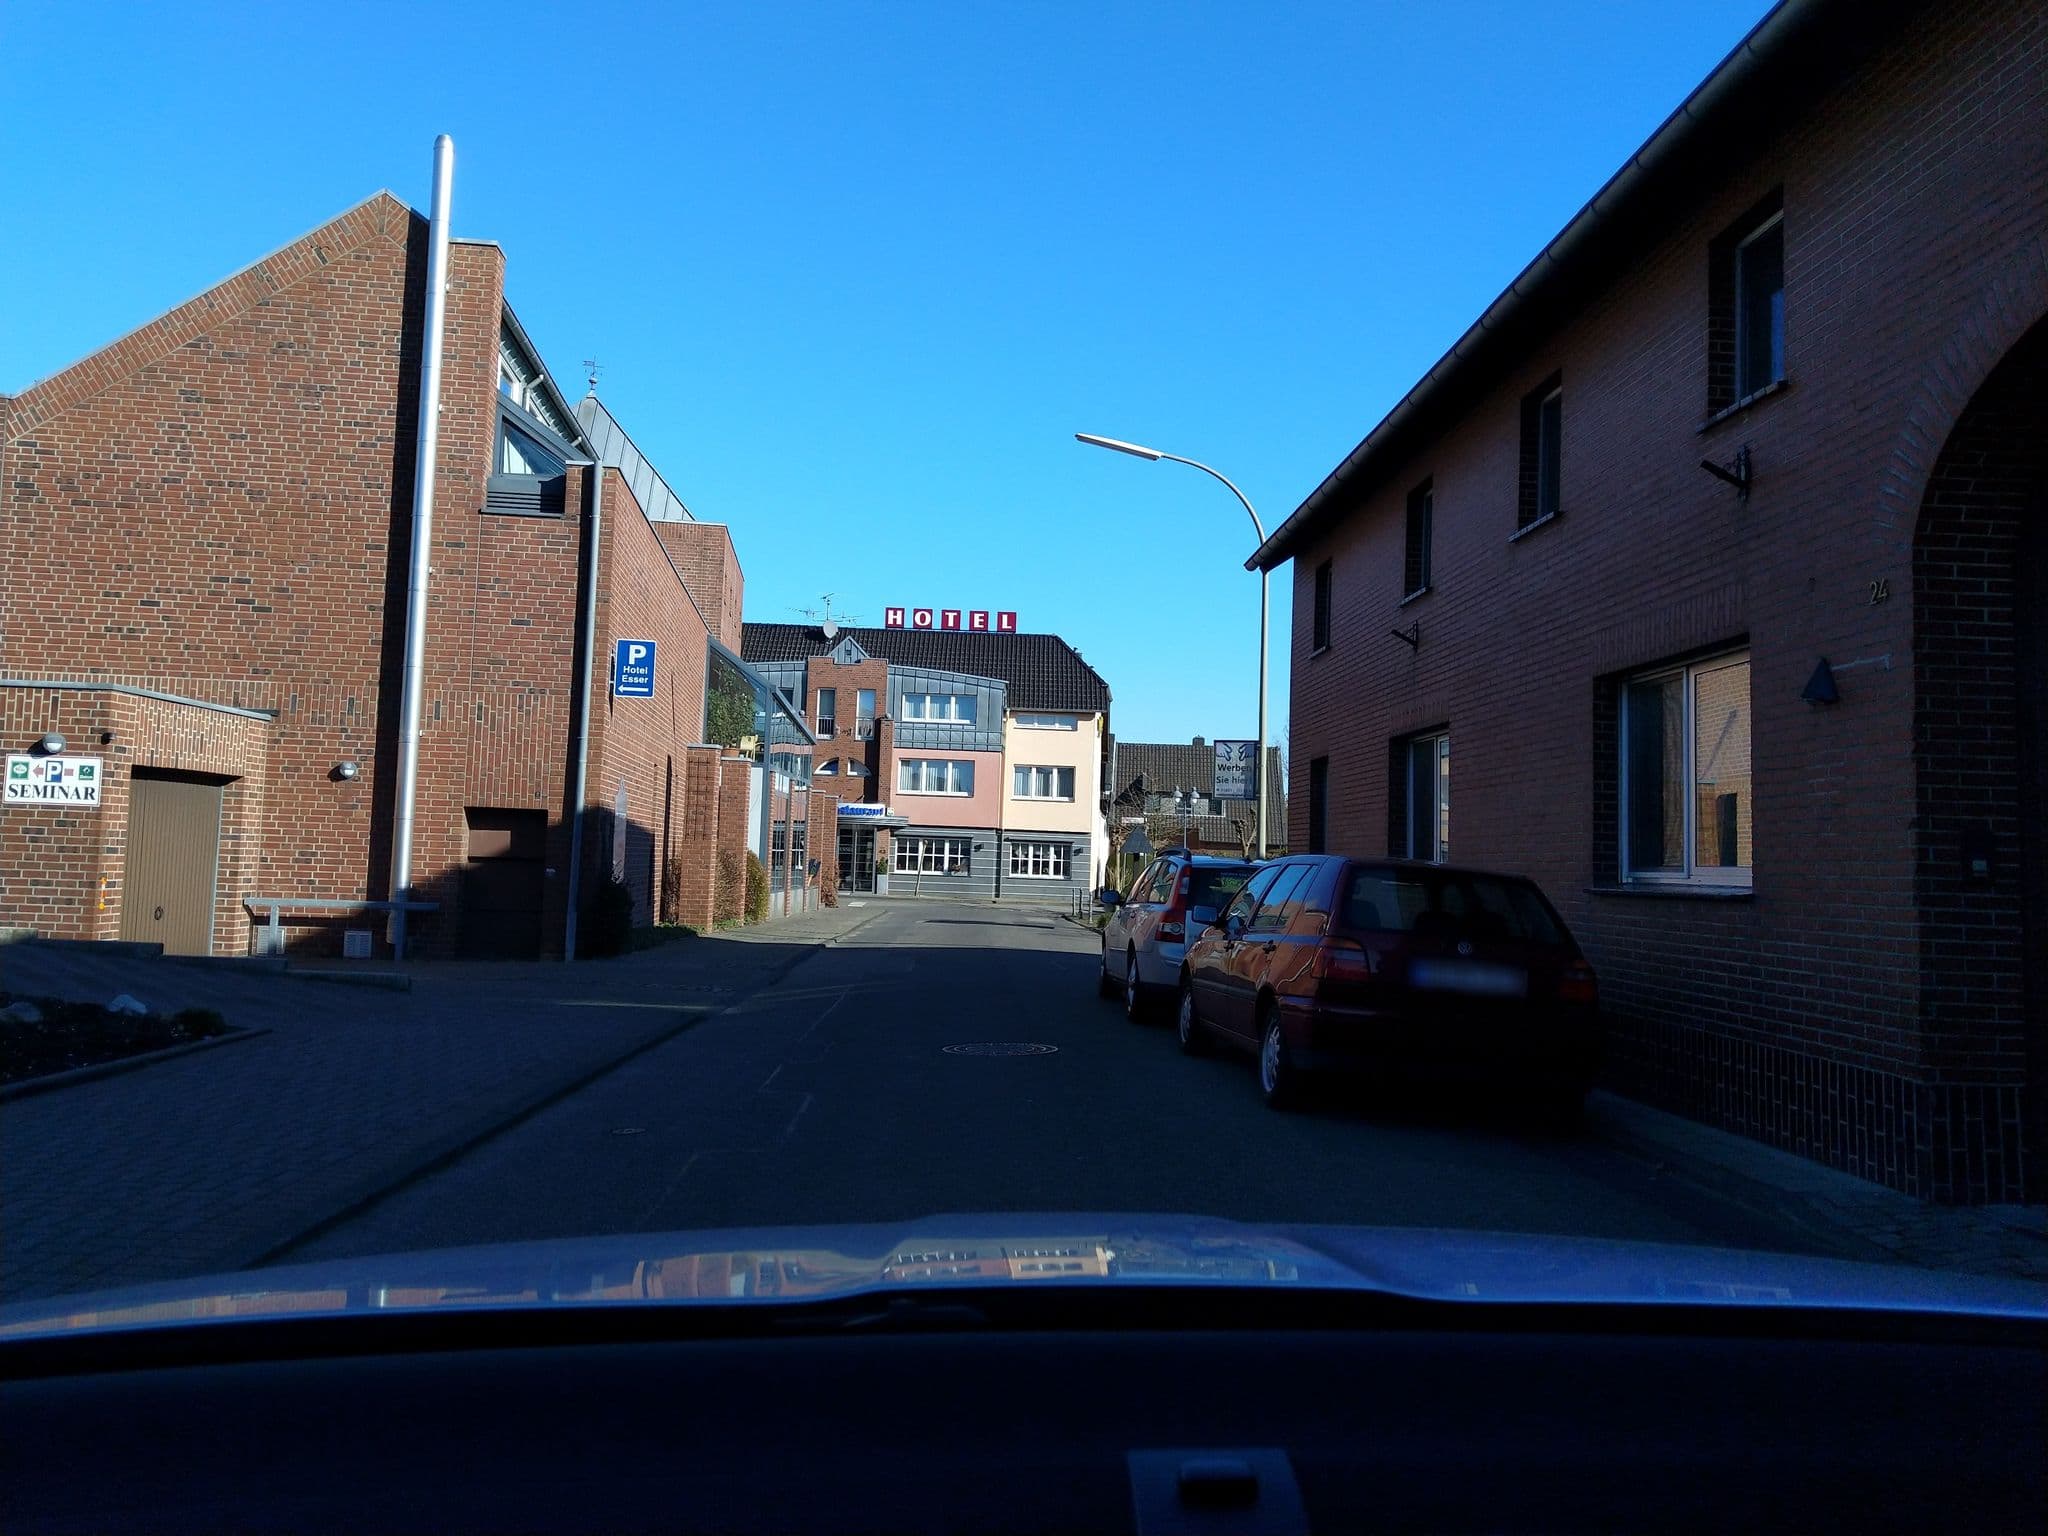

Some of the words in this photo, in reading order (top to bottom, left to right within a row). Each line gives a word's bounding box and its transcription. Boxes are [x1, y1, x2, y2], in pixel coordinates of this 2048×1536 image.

[1867, 577, 1888, 606] 24
[886, 608, 1013, 630] HOTEL
[628, 644, 647, 665] P
[621, 674, 649, 684] Esser
[623, 665, 648, 675] Hotel
[46, 761, 63, 782] P
[1217, 763, 1251, 772] Werben
[1216, 776, 1229, 784] Sie
[7, 783, 96, 801] SEMINAR
